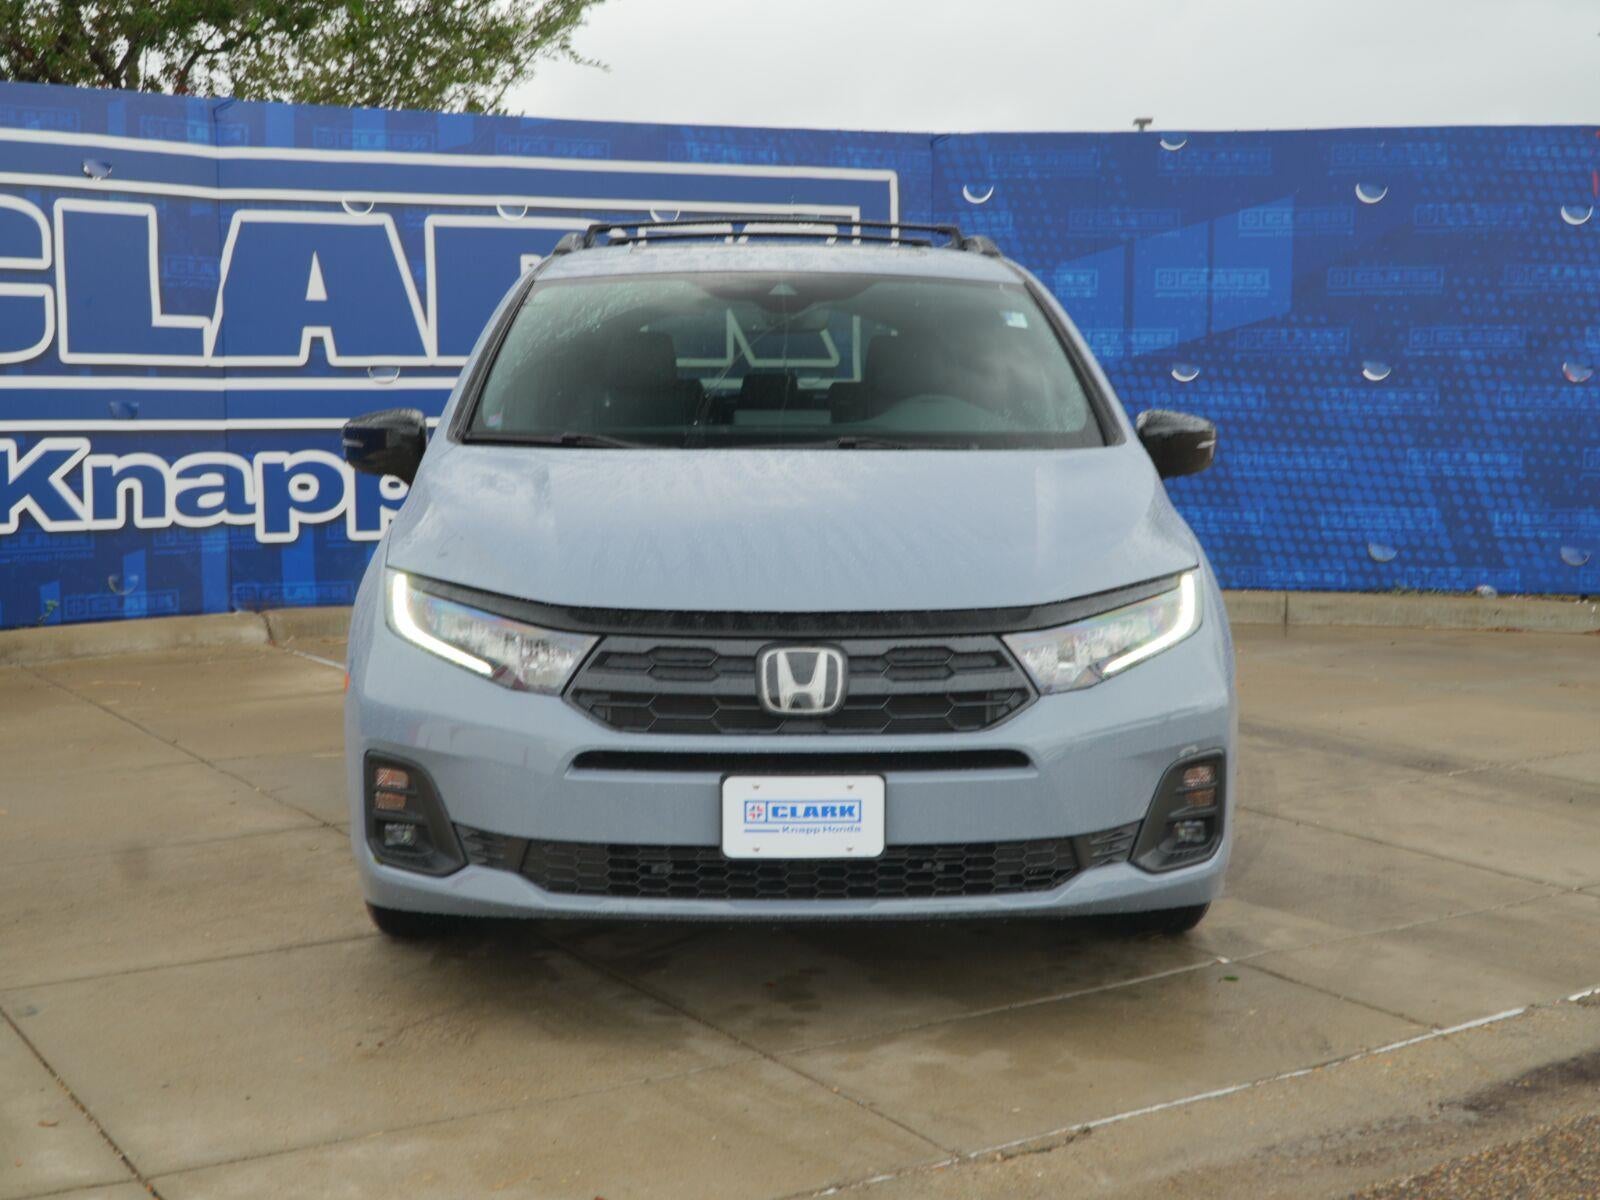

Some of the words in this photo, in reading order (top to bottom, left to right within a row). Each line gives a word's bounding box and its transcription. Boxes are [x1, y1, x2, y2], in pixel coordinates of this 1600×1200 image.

[771, 805, 856, 818] CLARK
[782, 825, 820, 835] Knapp
[822, 825, 861, 833] Honda
